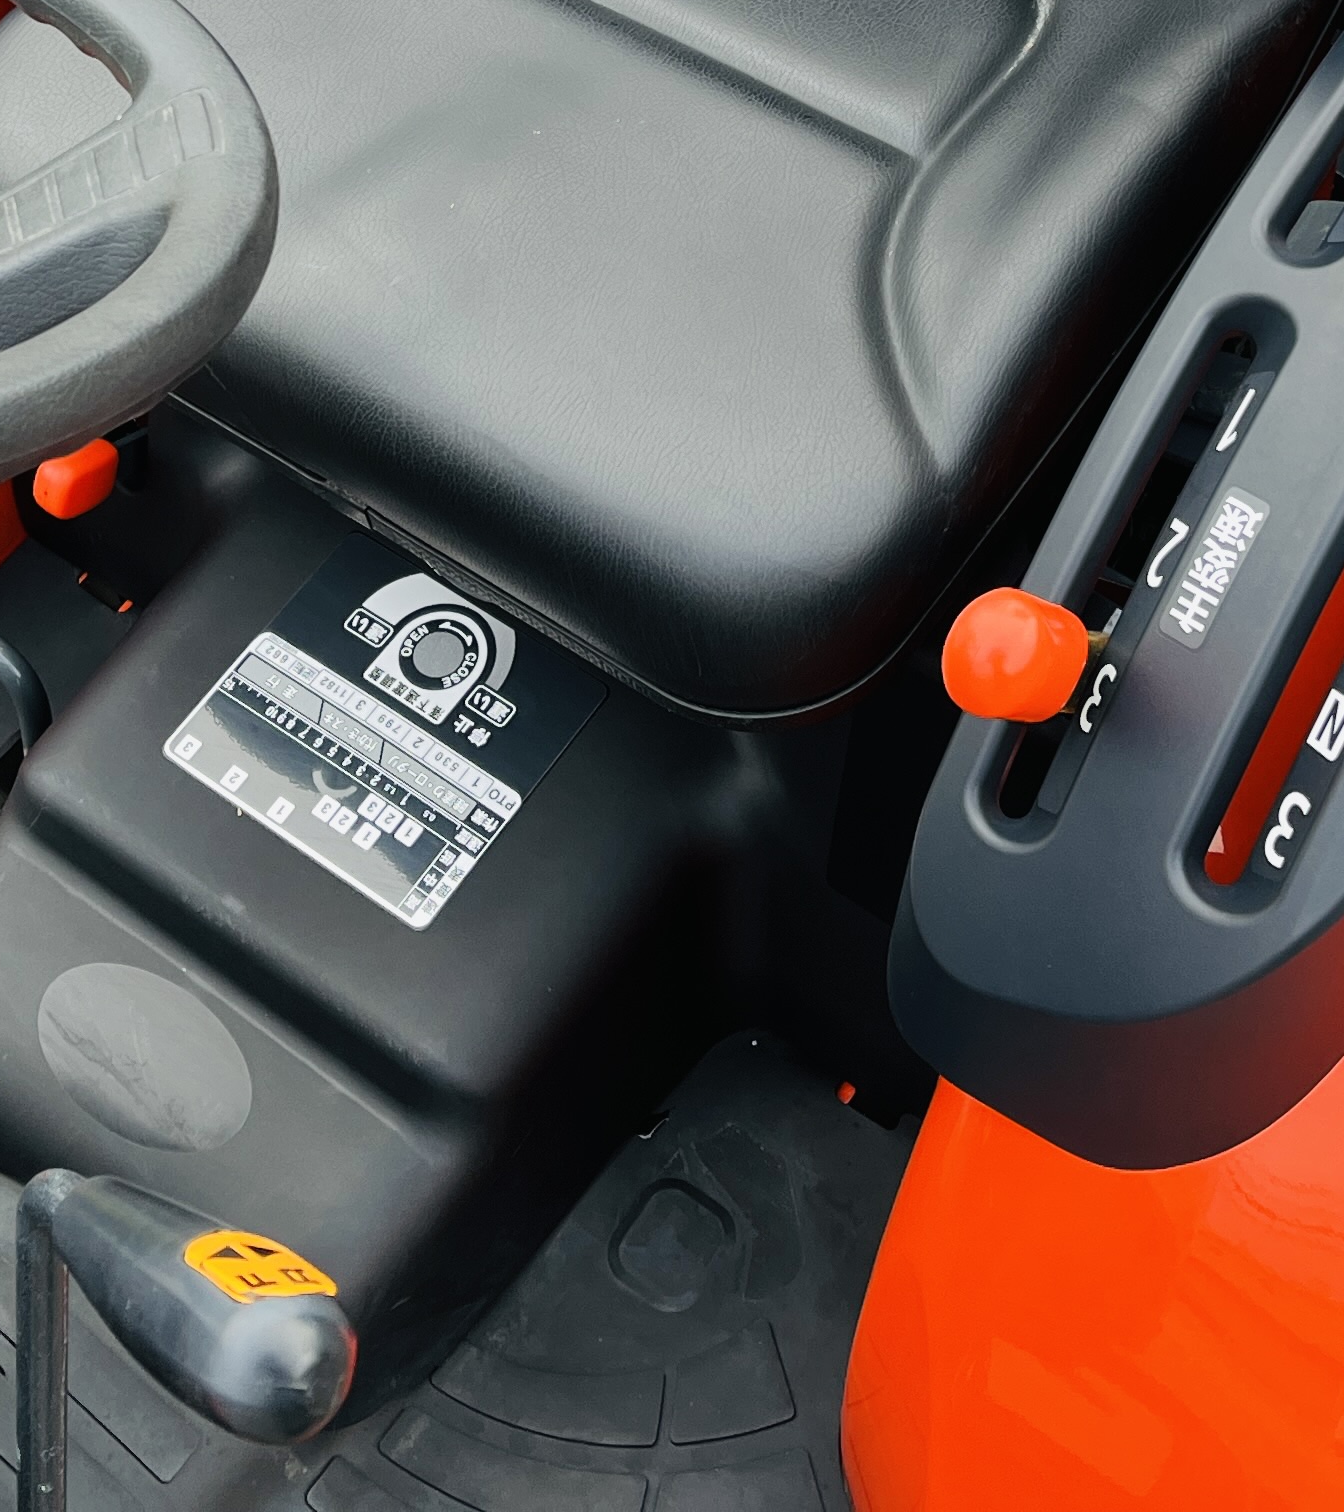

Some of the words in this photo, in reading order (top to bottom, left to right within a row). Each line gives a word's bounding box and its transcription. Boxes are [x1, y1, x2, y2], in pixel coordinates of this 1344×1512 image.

[1215, 387, 1256, 452] 1
[1146, 517, 1190, 588] 2
[1169, 496, 1263, 634] 主変速
[264, 644, 289, 664] 662
[401, 624, 430, 658] OPEN
[318, 675, 348, 698] 1182
[441, 652, 478, 688] CLOSE
[367, 665, 445, 721] 落下速度調整
[1078, 663, 1117, 734] 3
[376, 713, 403, 733] 799
[449, 713, 492, 748] 停止
[433, 751, 460, 771] 530
[486, 788, 515, 811] PTO
[1262, 790, 1312, 870] 3
[421, 871, 438, 887] 中
